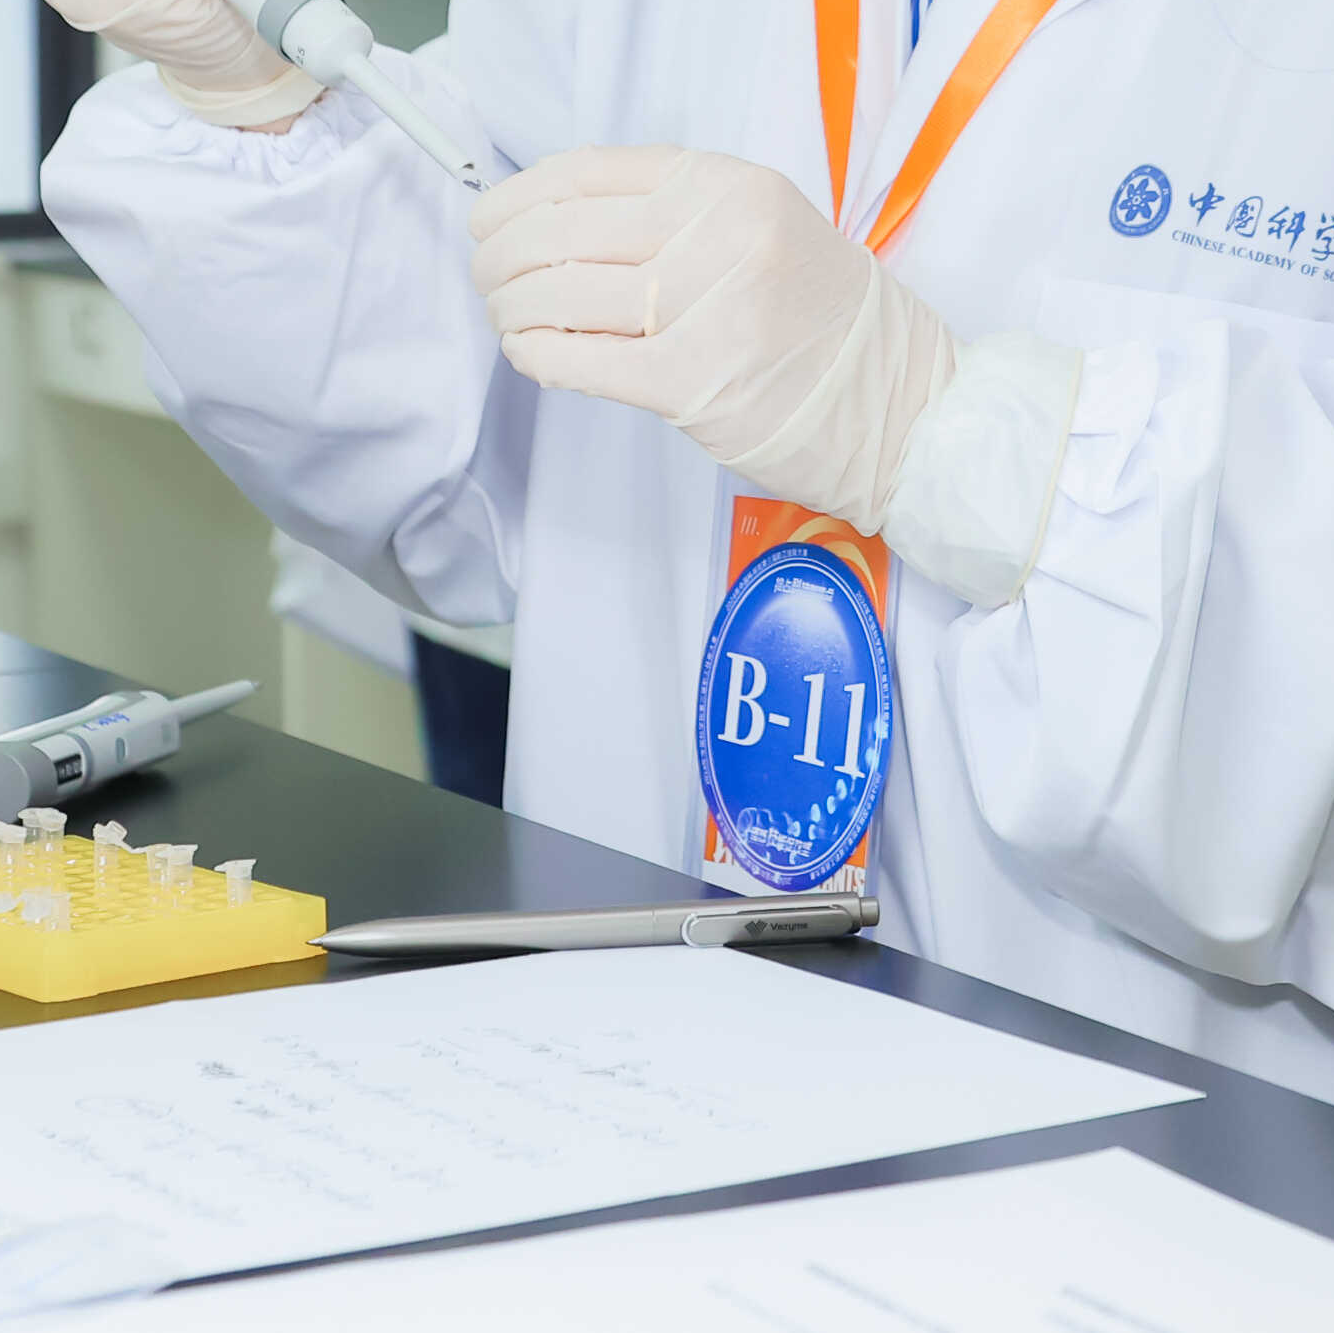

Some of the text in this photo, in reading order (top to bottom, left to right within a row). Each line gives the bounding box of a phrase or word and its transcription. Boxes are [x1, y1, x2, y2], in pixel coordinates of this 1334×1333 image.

[1171, 228, 1227, 254] CHINESE
[1228, 245, 1297, 271] ACADEMY
[1299, 263, 1320, 278] OF
[717, 651, 867, 779] B-11
